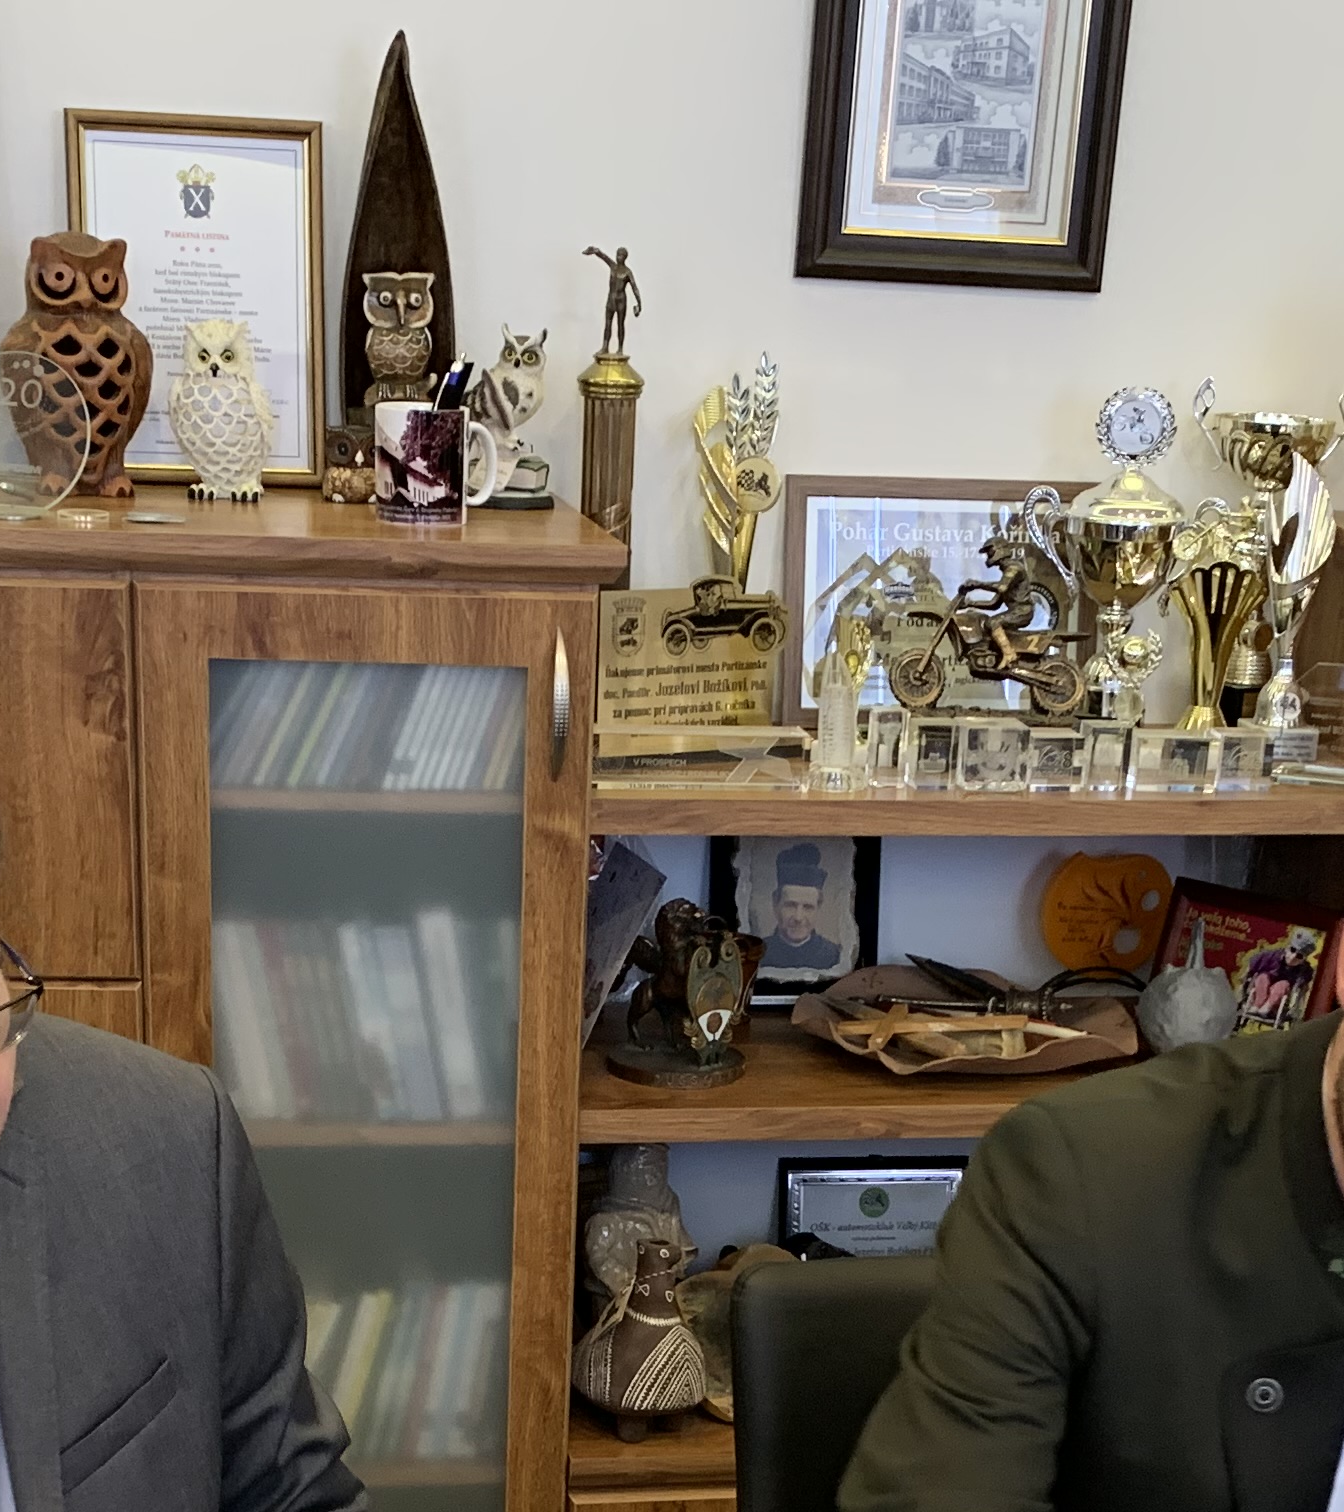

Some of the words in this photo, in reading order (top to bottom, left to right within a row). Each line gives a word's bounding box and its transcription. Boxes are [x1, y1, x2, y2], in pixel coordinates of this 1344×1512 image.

[831, 521, 889, 541] Pohár
[894, 522, 972, 542] Gustava
[721, 659, 767, 672] Partizánske
[640, 758, 687, 767] PROSPECH
